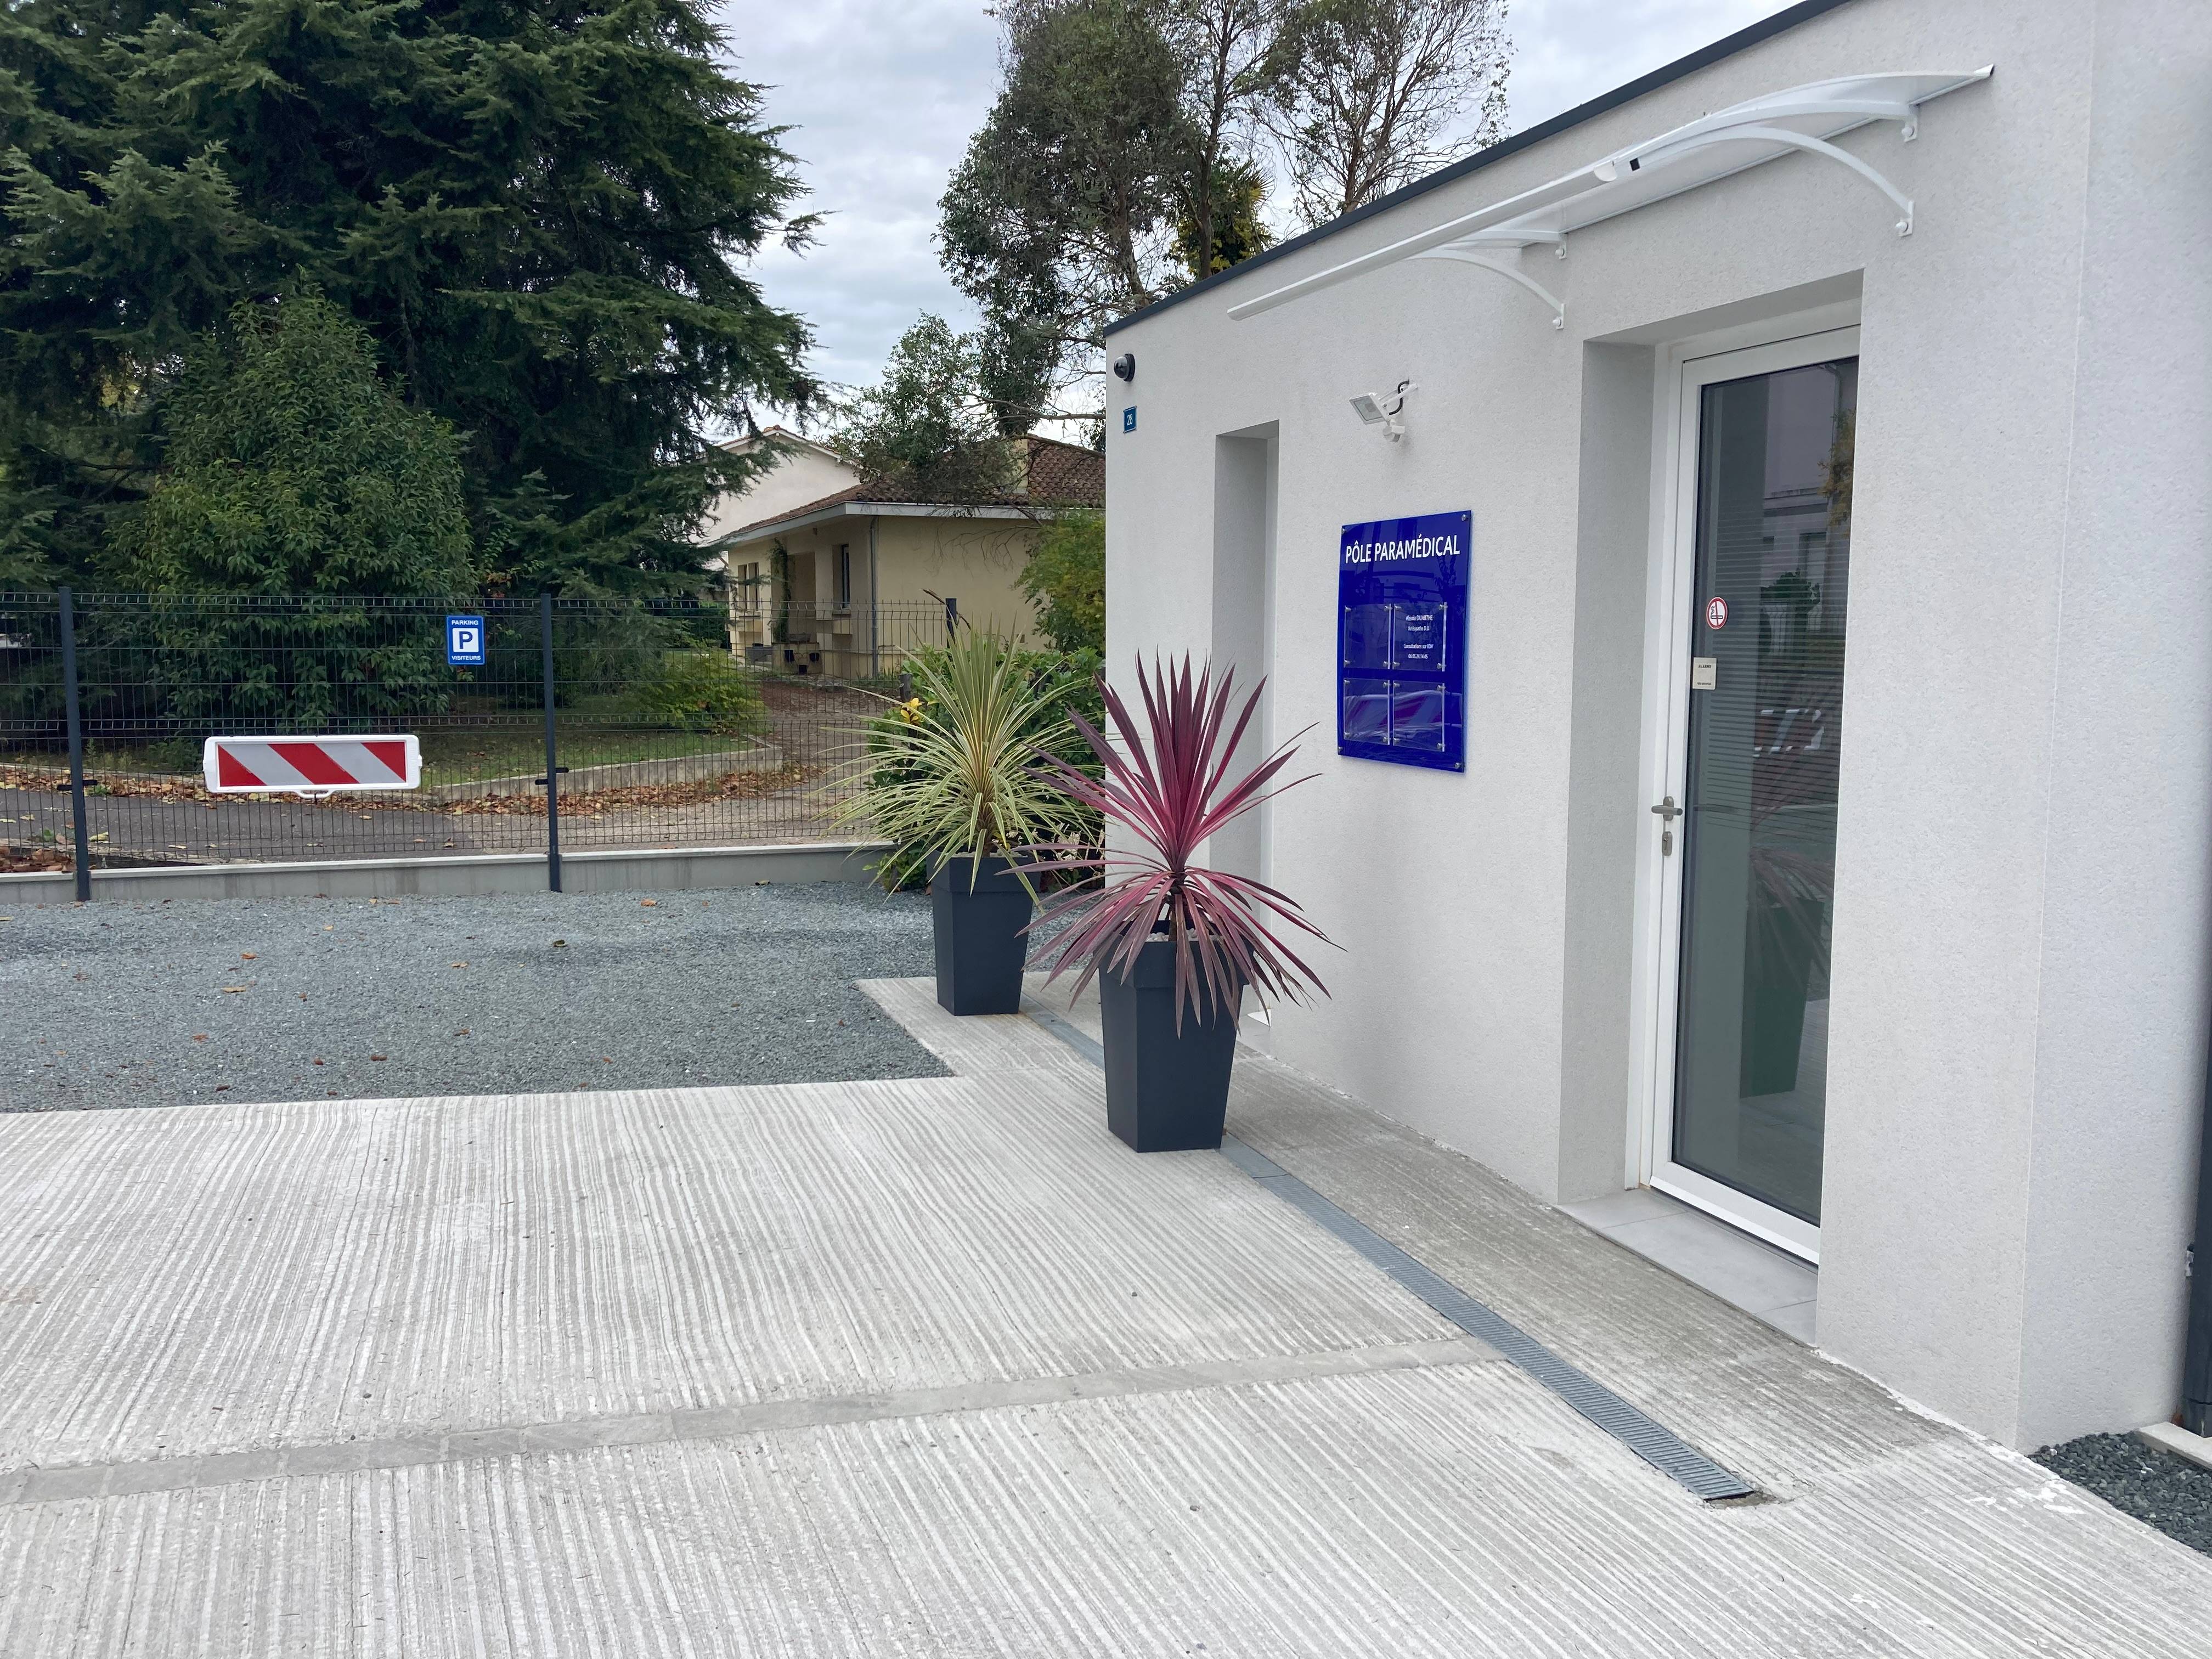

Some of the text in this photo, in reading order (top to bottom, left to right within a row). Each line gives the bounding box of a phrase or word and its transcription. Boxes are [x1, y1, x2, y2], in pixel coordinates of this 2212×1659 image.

[1127, 413, 1133, 426] 28
[1346, 533, 1460, 564] PÔLE PARAMÉDICAL
[459, 631, 473, 650] P
